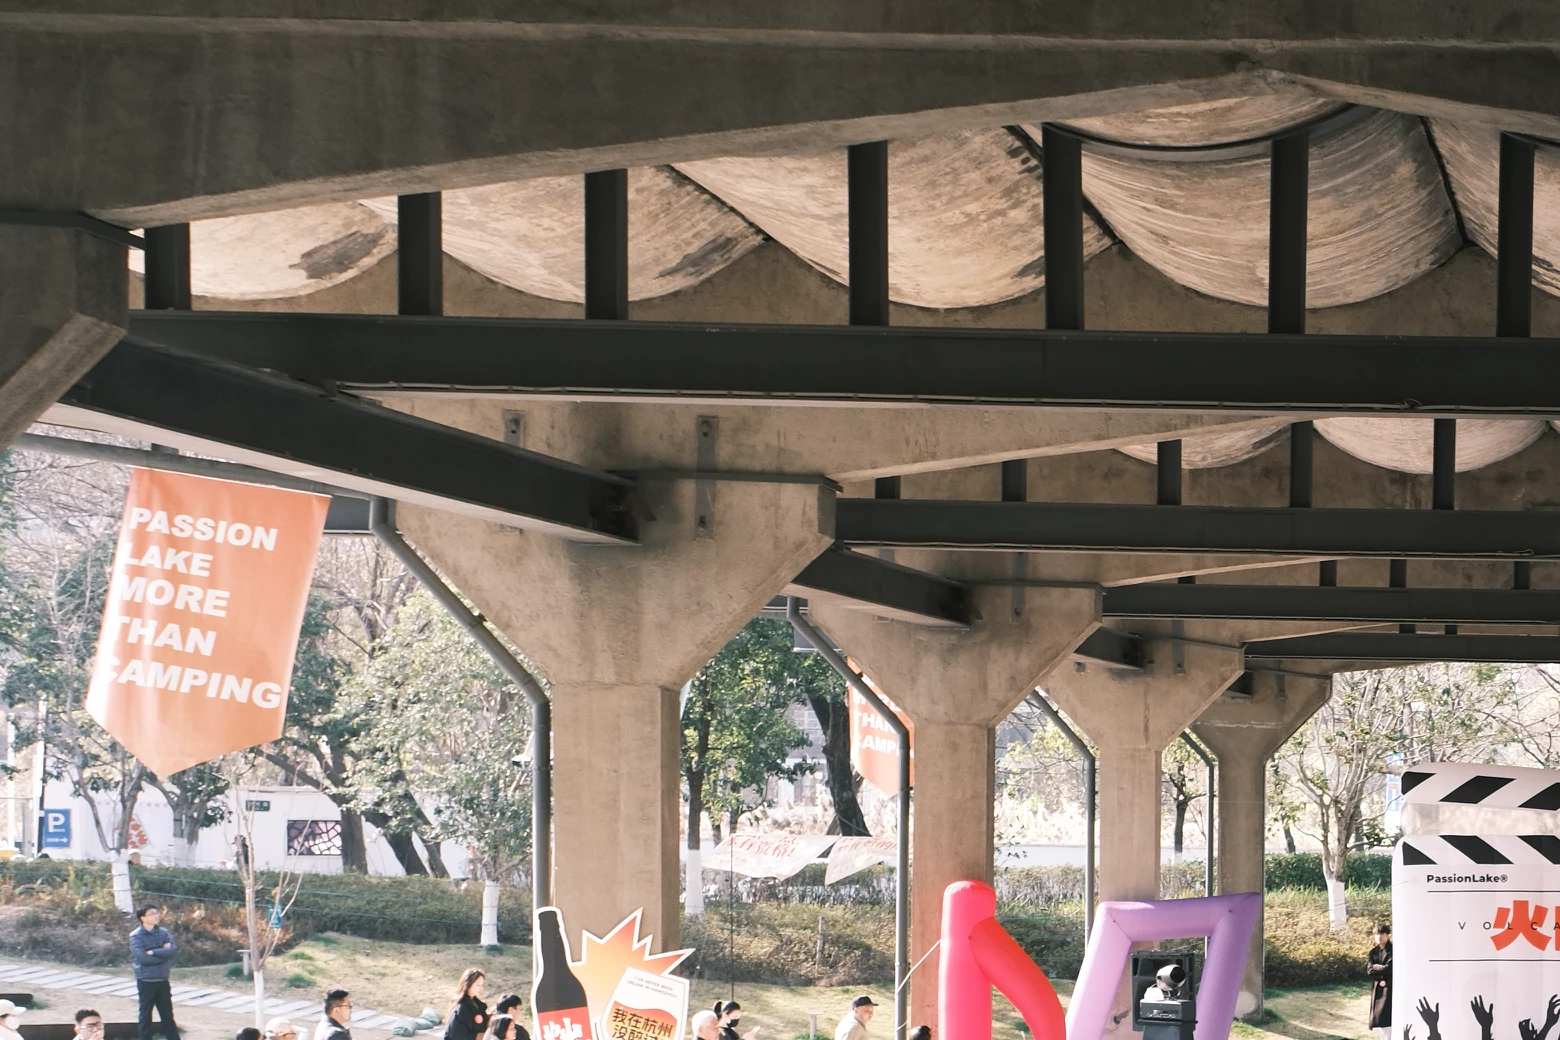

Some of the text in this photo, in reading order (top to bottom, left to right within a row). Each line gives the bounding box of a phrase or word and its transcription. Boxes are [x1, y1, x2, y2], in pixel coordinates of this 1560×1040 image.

[129, 507, 278, 551] PASSION
[123, 542, 213, 577] LAKE
[121, 574, 229, 617] MORE
[116, 615, 216, 657] THAN
[103, 654, 282, 709] CAMPING
[47, 813, 66, 833] P
[612, 1008, 674, 1038] 我在杭州
